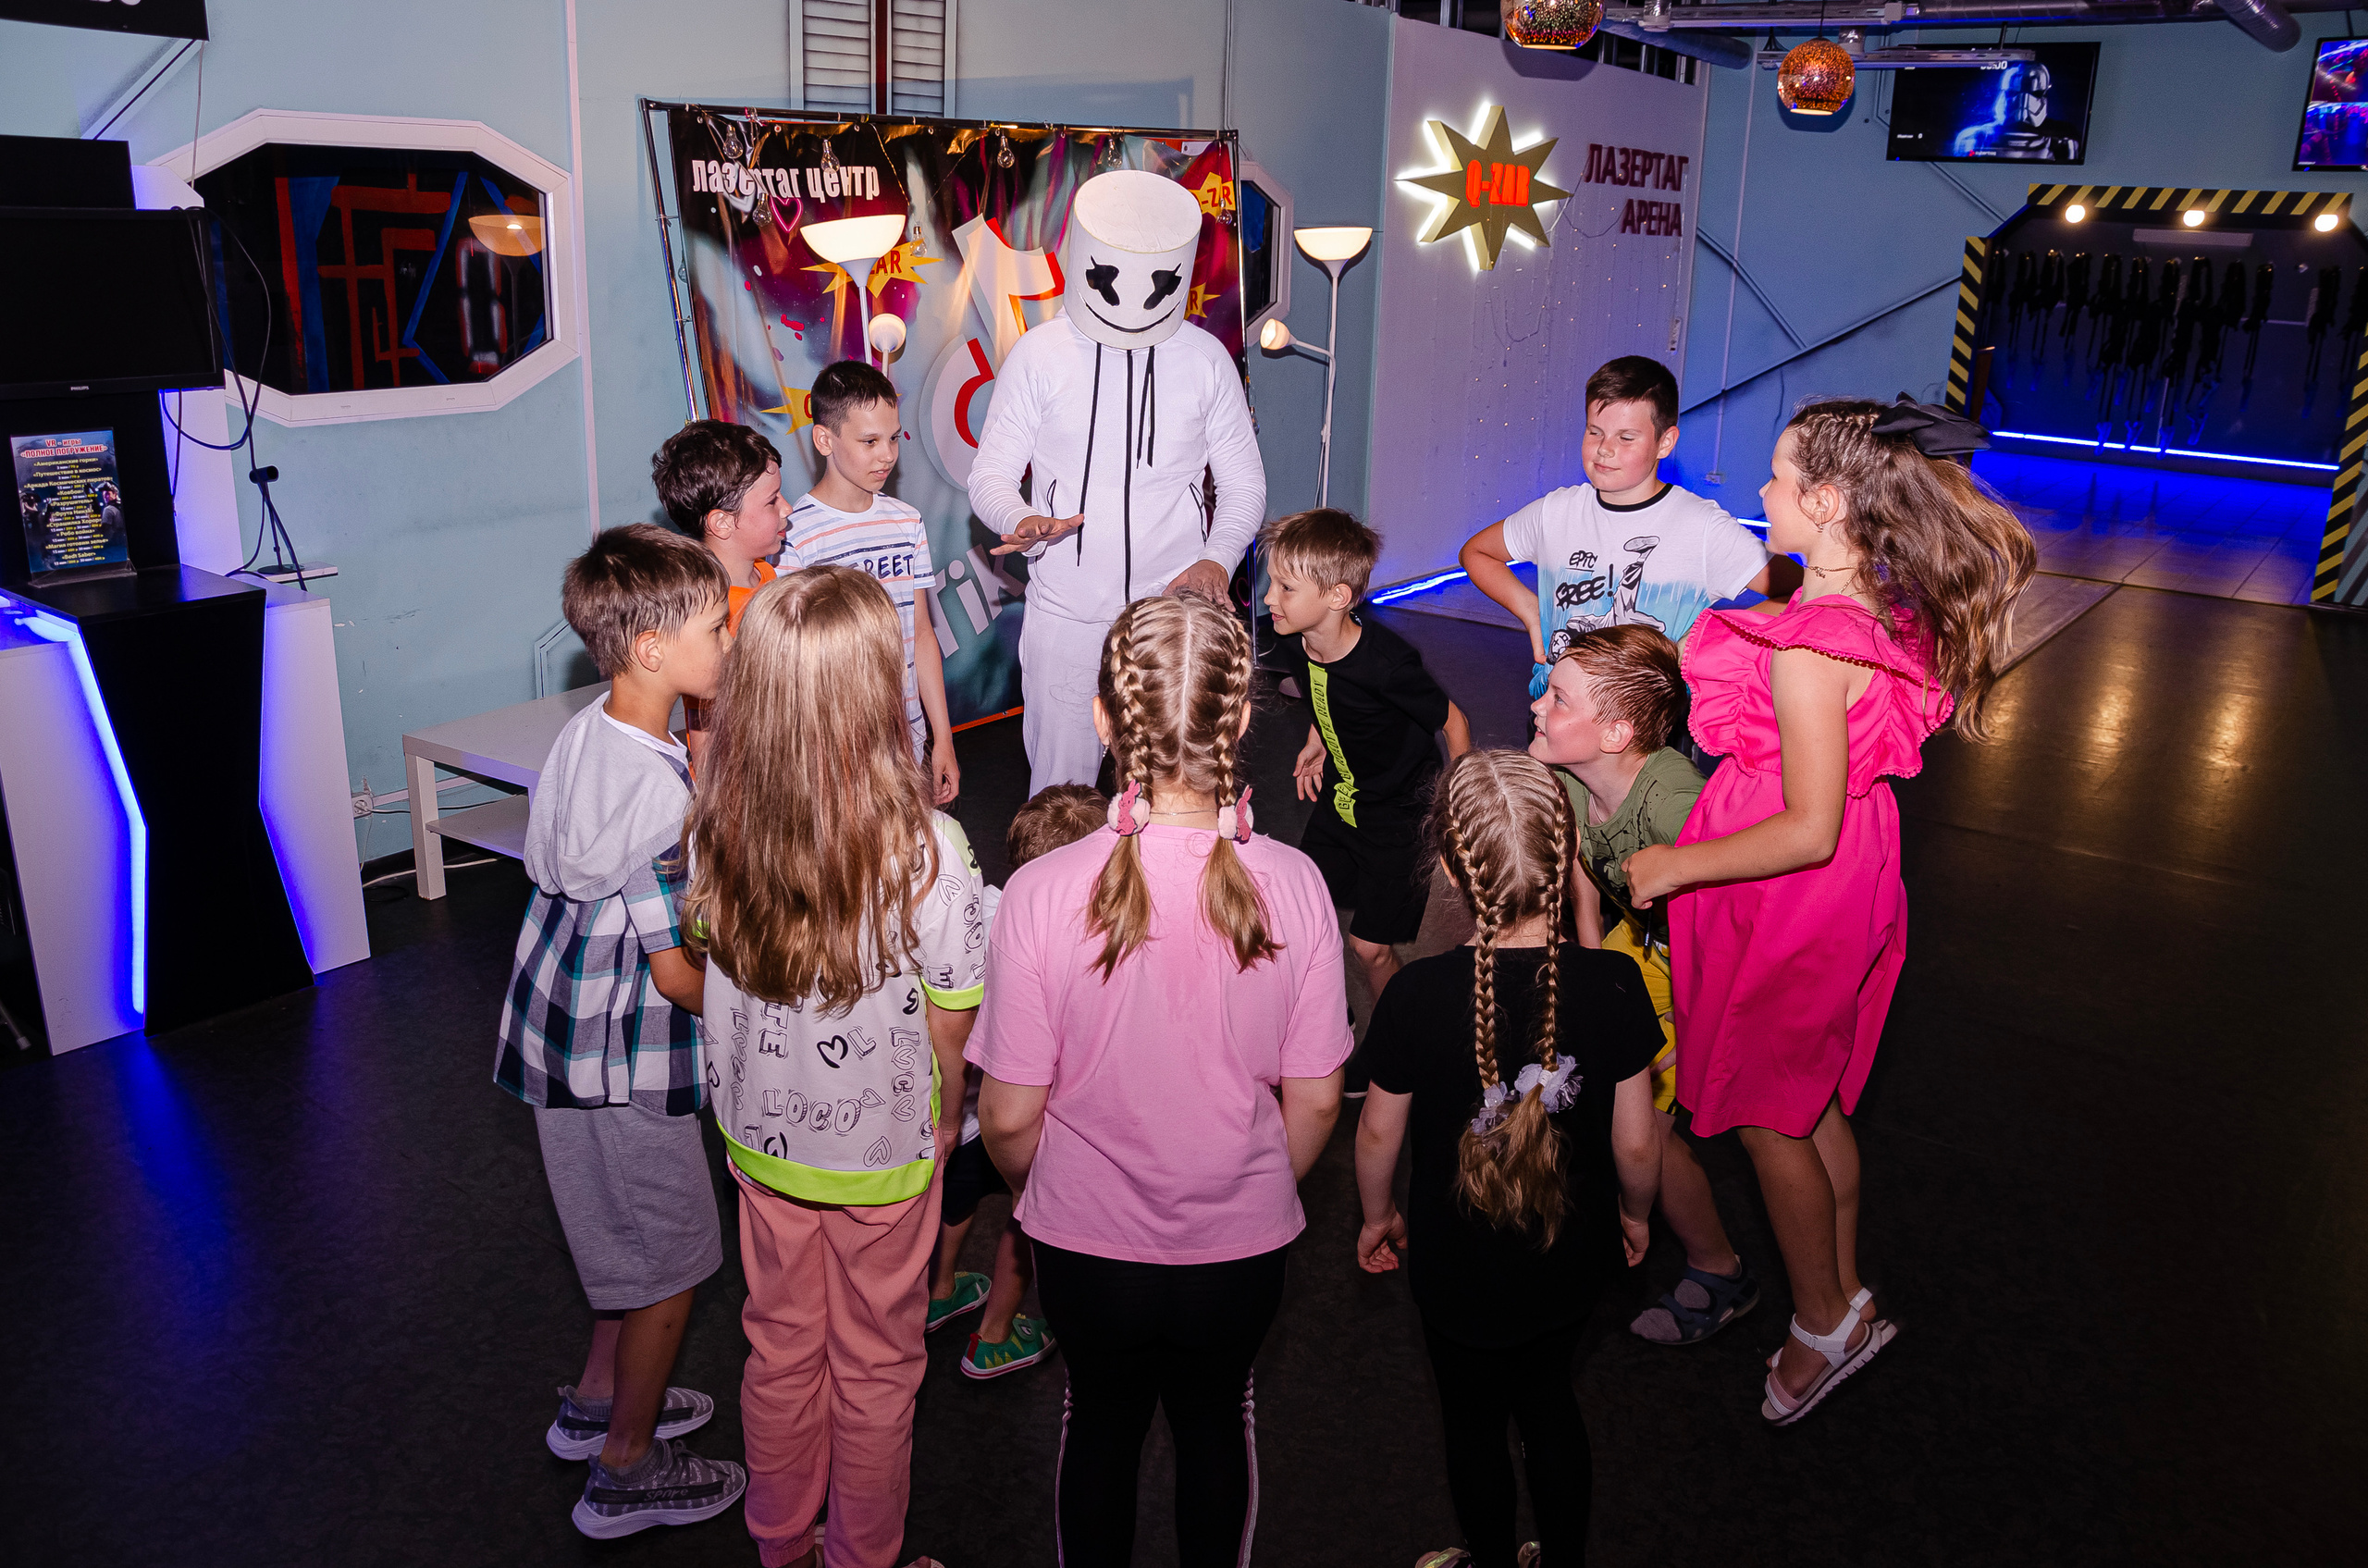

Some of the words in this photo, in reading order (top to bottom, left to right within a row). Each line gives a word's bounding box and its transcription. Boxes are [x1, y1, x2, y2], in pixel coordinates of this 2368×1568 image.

[806, 166, 881, 204] центр
[1584, 143, 1689, 191] ЛАЗЕРТАГ
[1621, 198, 1683, 237] АРЕНА
[761, 1089, 862, 1134] LOCO
